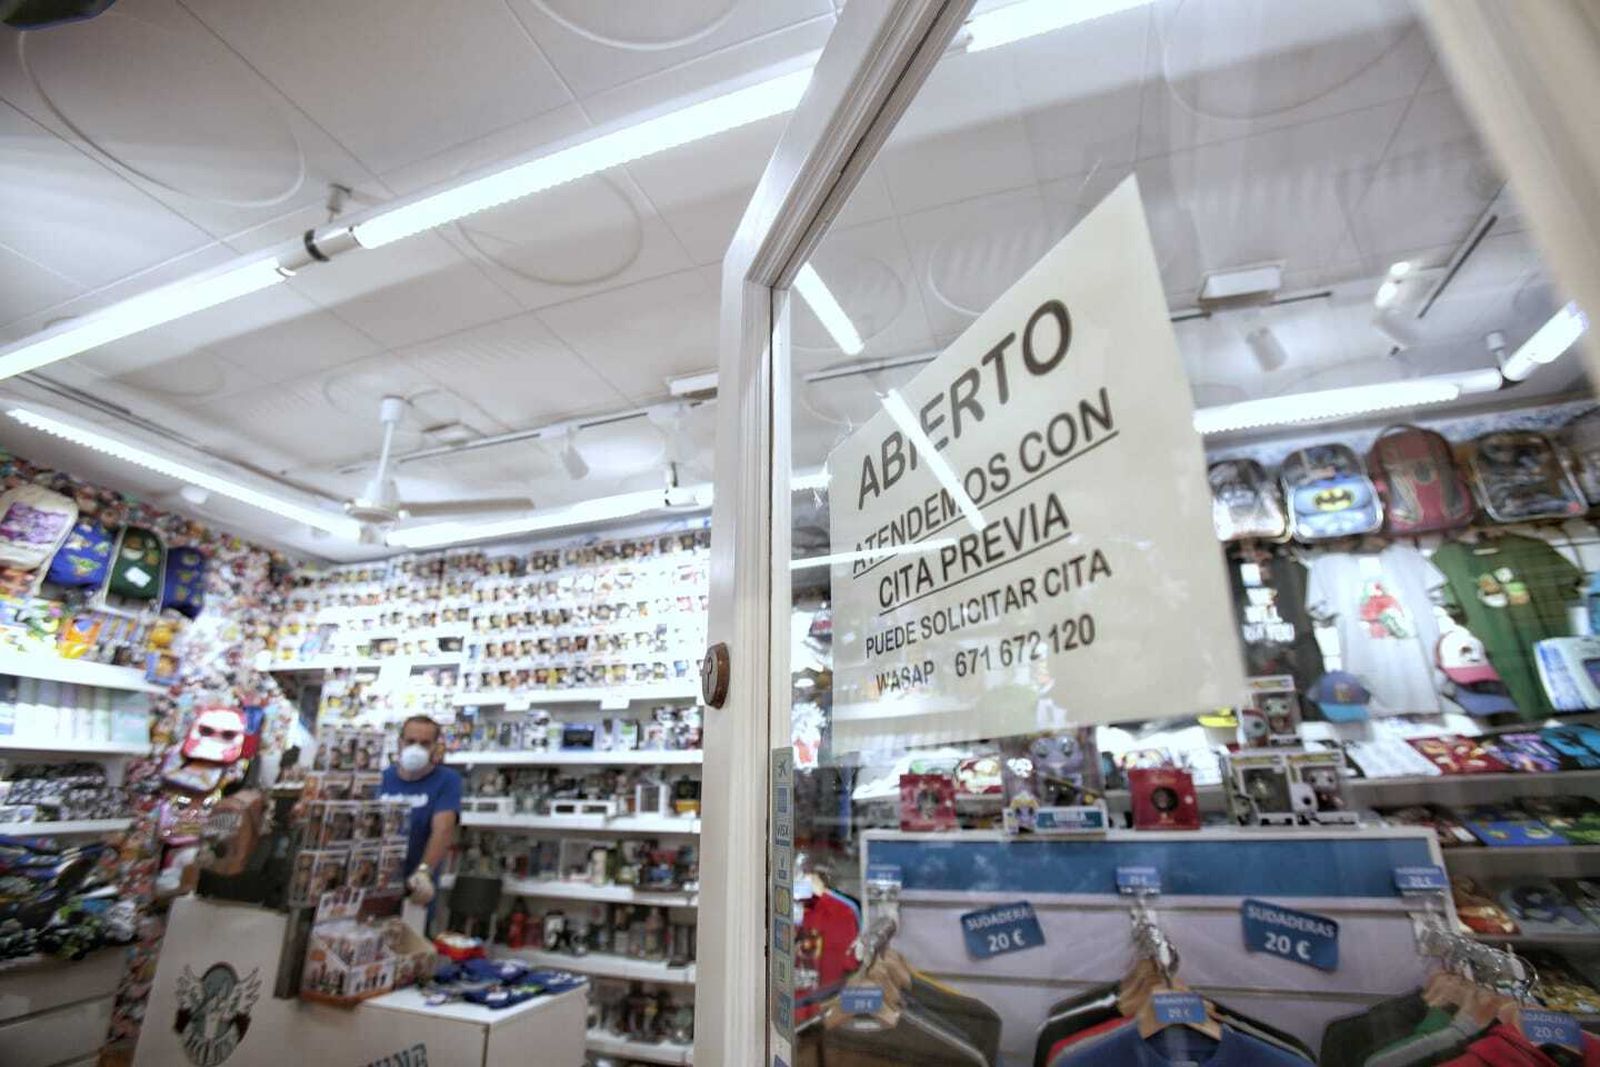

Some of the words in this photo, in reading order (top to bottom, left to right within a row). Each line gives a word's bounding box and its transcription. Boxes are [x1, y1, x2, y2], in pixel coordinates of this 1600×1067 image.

[858, 299, 1073, 511] ABIERTO
[853, 452, 1011, 573] ATENDEMOS
[1019, 386, 1114, 473] CON
[866, 621, 917, 659] PUEDE
[920, 577, 1038, 640] SOLICITAR
[1043, 549, 1112, 598] CITA
[878, 557, 934, 609] CITA
[939, 492, 1071, 582] PREVIA
[875, 660, 935, 696] WASAP
[955, 645, 991, 678] 671
[999, 631, 1042, 668] 672
[1049, 613, 1096, 654] 120
[987, 932, 1010, 952] 20
[1013, 929, 1026, 947] €
[1263, 931, 1291, 955] 20
[1296, 940, 1312, 960] €
